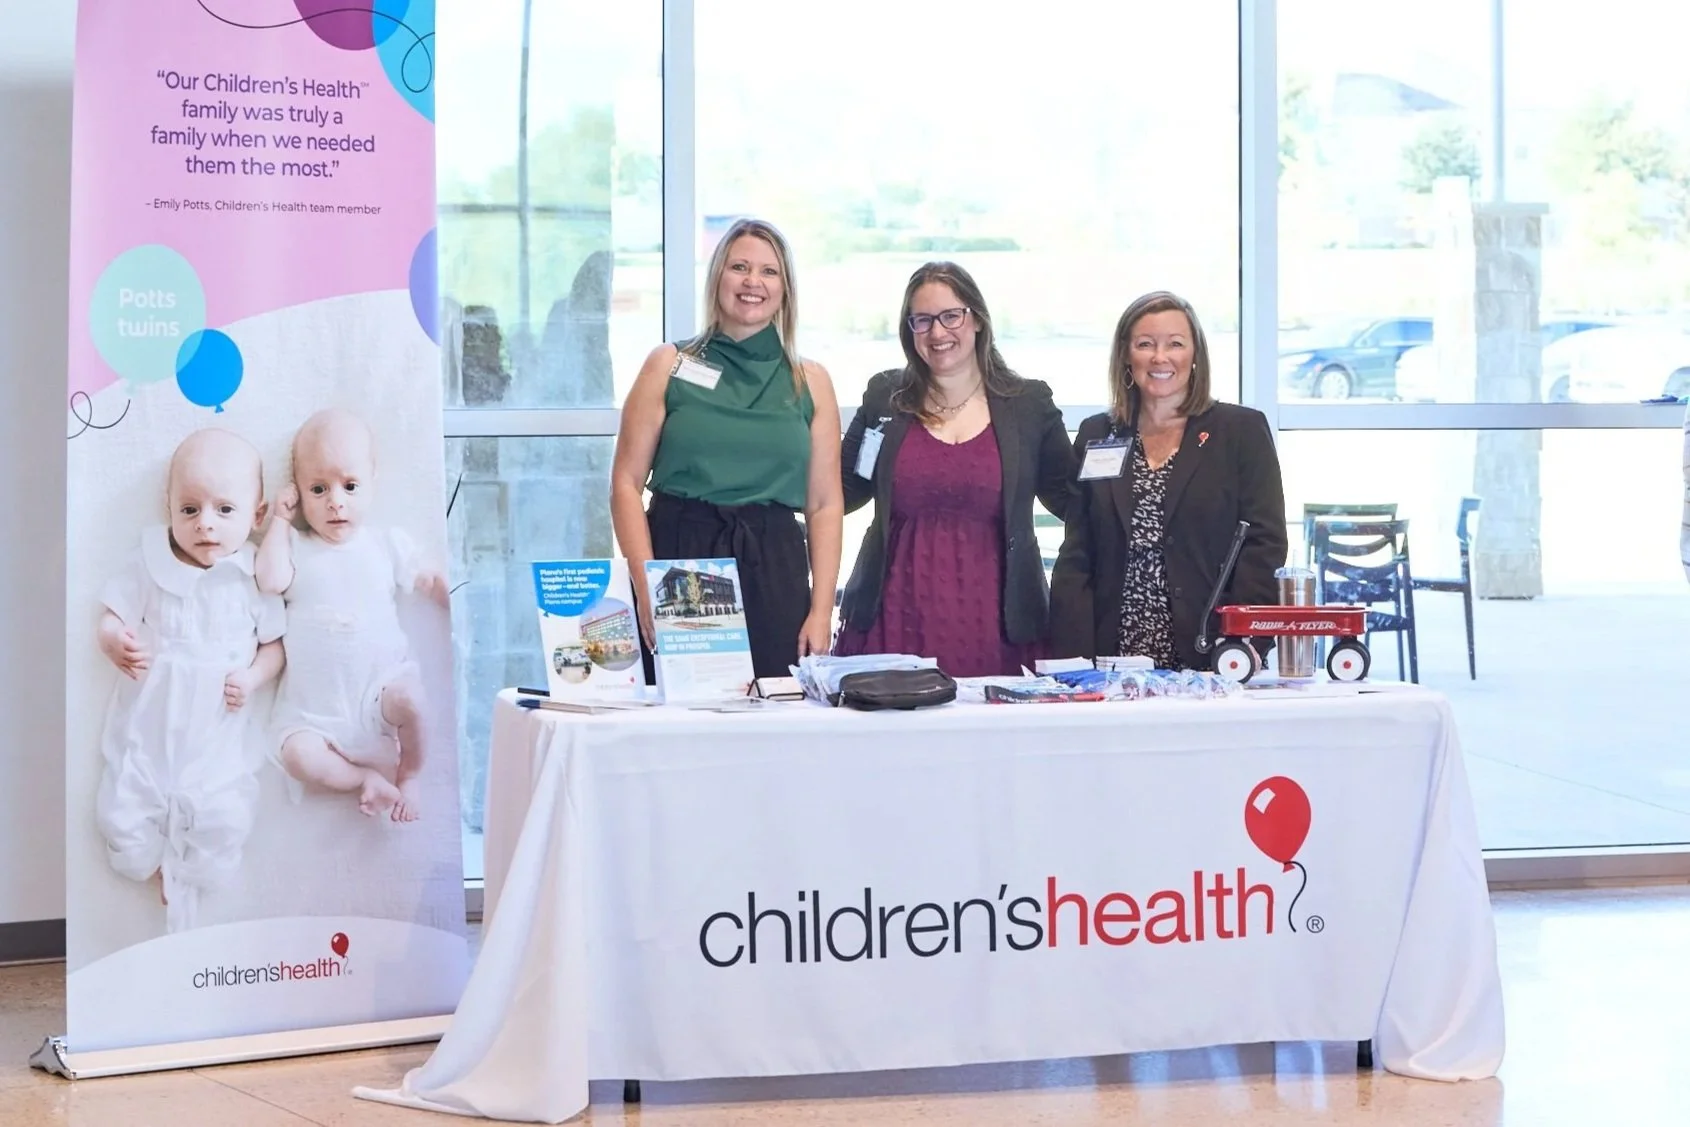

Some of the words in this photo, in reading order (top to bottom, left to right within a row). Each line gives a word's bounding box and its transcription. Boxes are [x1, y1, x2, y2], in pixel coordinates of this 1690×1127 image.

[157, 70, 199, 90] “Our
[204, 73, 298, 95] Children’s
[181, 99, 238, 124] family
[243, 106, 284, 121] was
[289, 105, 329, 128] truly
[333, 110, 343, 125] a
[150, 125, 207, 150] family
[211, 129, 267, 148] when
[272, 135, 302, 149] we
[307, 135, 375, 152] needed
[185, 155, 235, 175] them
[241, 158, 276, 175] the
[282, 160, 339, 178] most.”
[153, 199, 181, 212] Emily
[183, 199, 213, 212] Potts,
[215, 200, 269, 212] Children’s
[272, 202, 308, 213] Health
[310, 203, 335, 214] team
[337, 204, 381, 215] member
[119, 288, 176, 310] Potts
[117, 316, 180, 337] twins
[1299, 621, 1337, 630] FLYER
